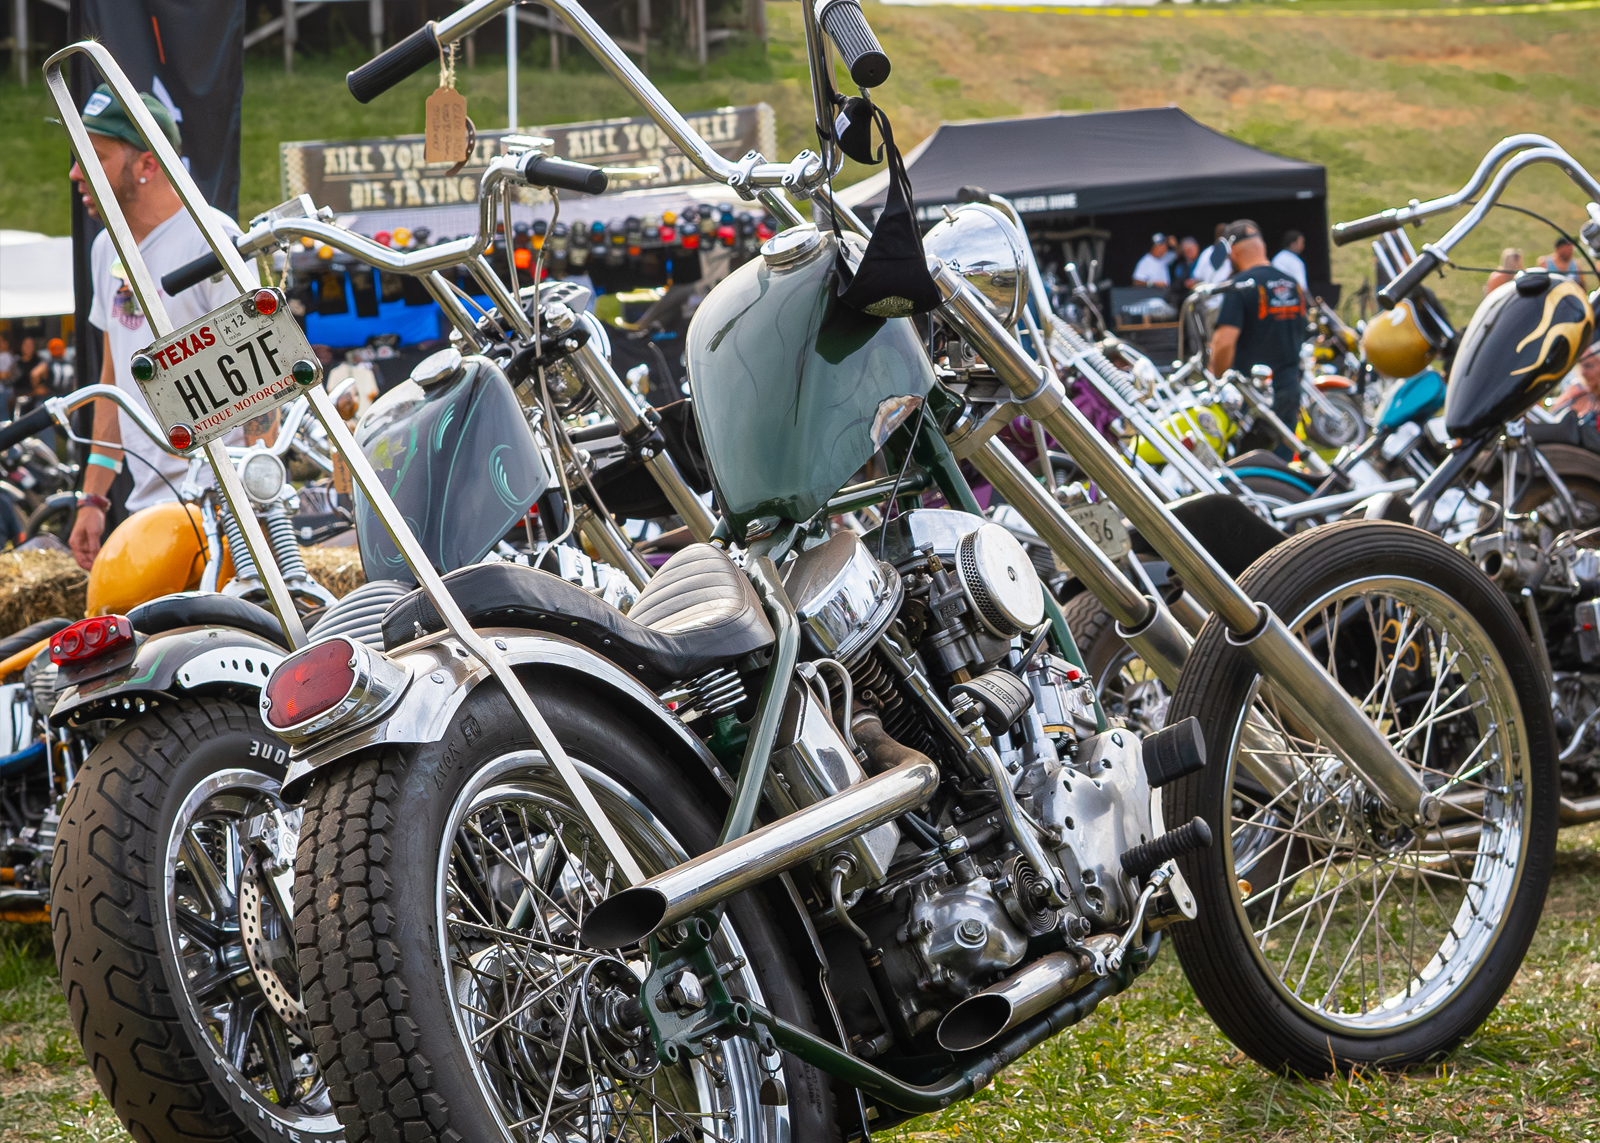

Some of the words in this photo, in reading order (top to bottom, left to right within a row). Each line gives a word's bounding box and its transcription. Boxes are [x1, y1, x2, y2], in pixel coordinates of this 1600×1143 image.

[323, 146, 376, 174] KILL
[350, 181, 386, 209] DIE
[390, 177, 476, 206] TRYING
[231, 315, 246, 328] 12
[153, 326, 216, 371] TEXAS
[173, 330, 282, 420] HL67F
[233, 374, 297, 413] MOTORCYC
